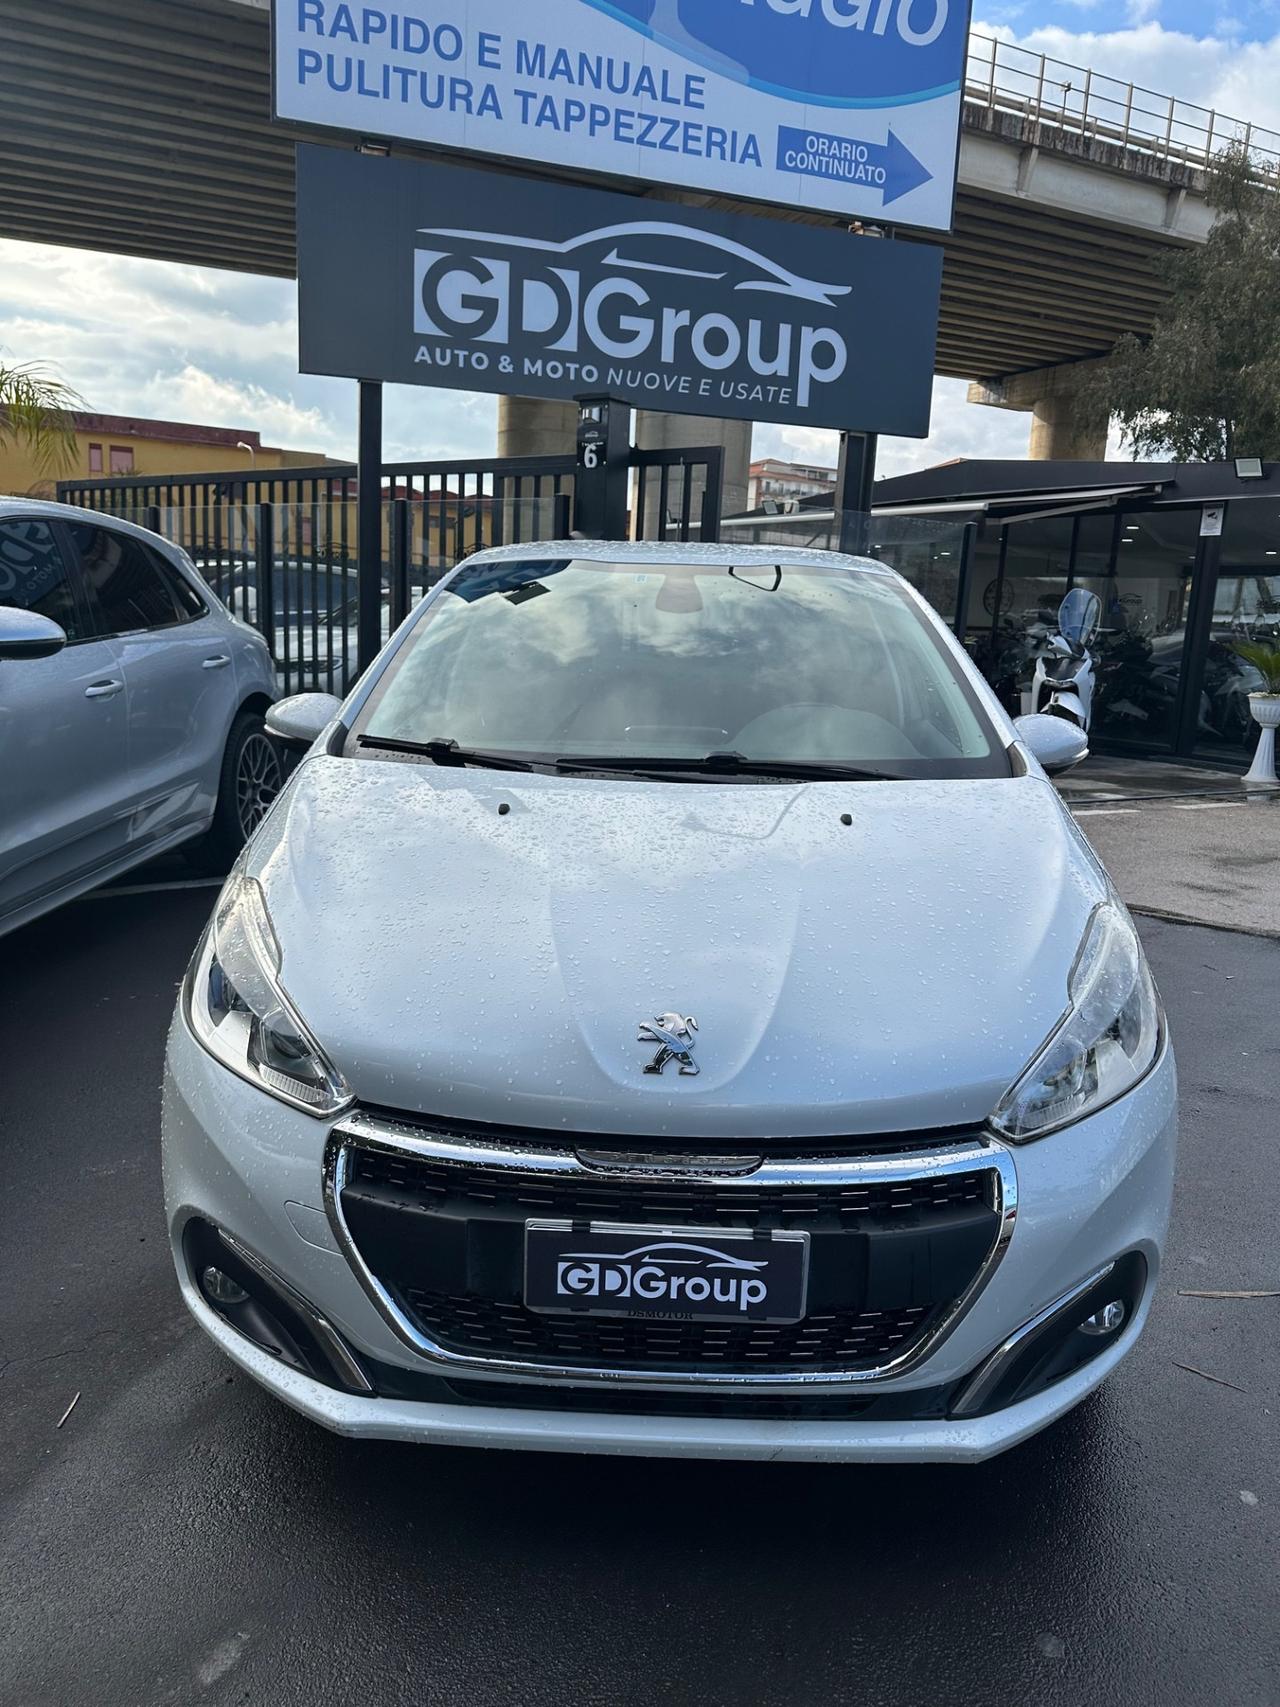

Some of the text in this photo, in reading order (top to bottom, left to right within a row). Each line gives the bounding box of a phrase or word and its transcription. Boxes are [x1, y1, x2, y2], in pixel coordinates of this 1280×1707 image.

[297, 0, 706, 110] RAPIDO E MANUALE
[297, 48, 763, 168] PULITURA TAPPEZZERIA
[785, 150, 887, 185] CONTINUATO
[805, 135, 869, 163] ORARIO
[413, 248, 848, 408] GDGroup
[414, 345, 793, 405] AUTO & MOTO NUOVE E USATE
[583, 444, 598, 469] 6
[557, 1262, 768, 1310] GDGroup
[627, 1309, 694, 1320] DSMOTOR
